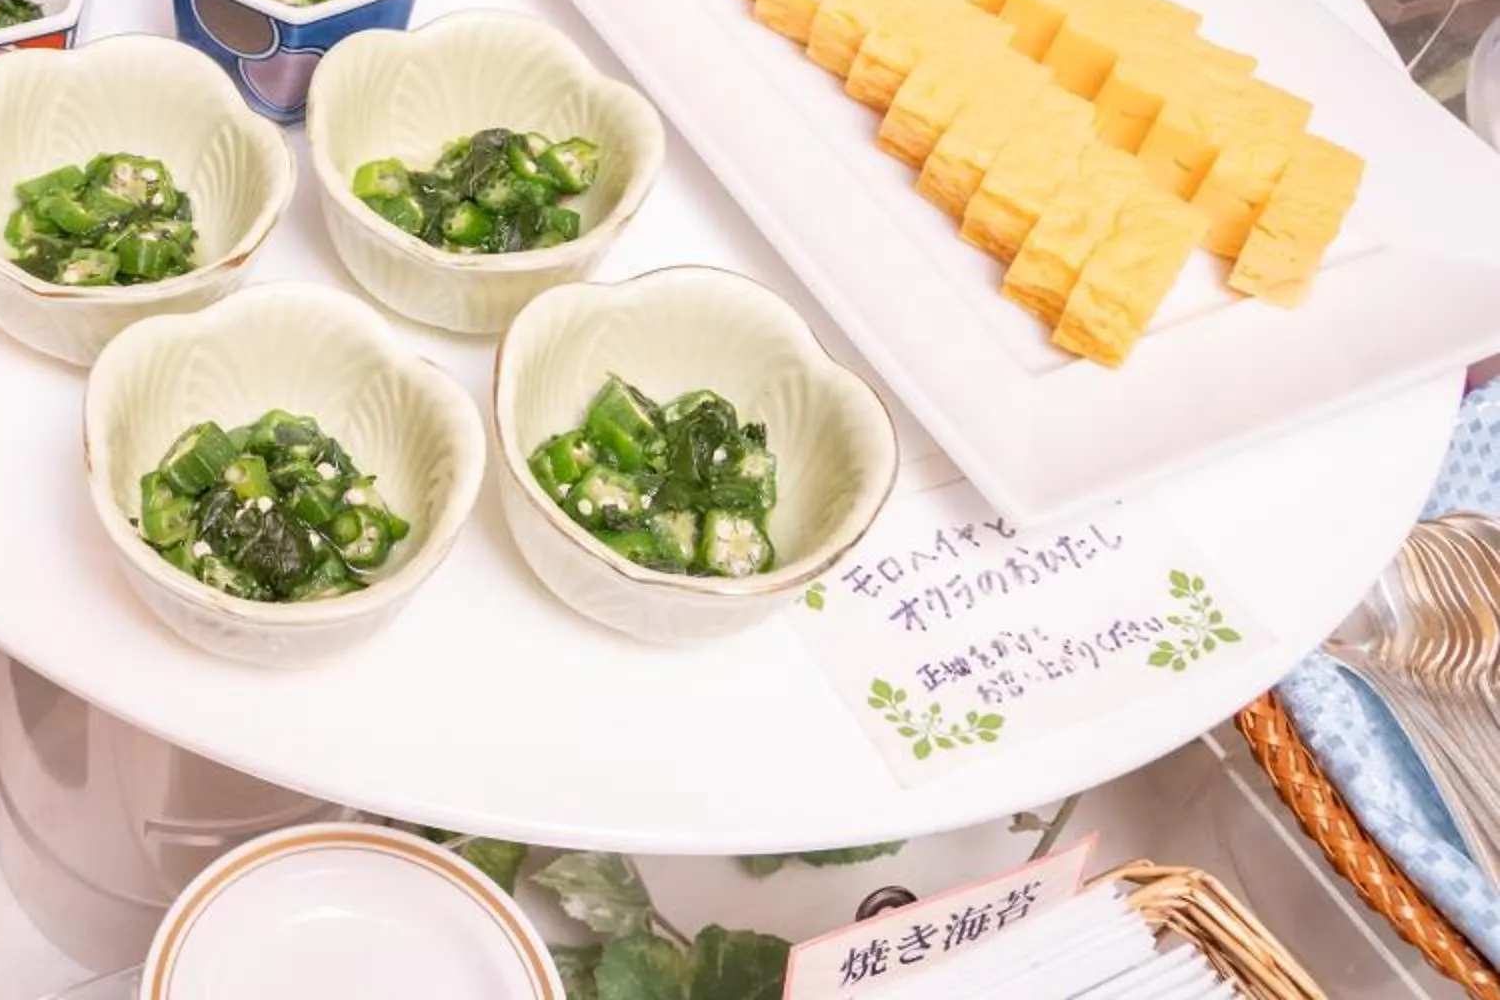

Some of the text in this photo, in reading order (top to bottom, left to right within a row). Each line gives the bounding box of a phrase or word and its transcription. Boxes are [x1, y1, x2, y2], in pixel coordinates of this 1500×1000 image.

[840, 516, 1017, 598] モロヘイヤと
[888, 523, 1124, 632] オクラのおひたし
[838, 880, 1043, 987] 焼き海苔
